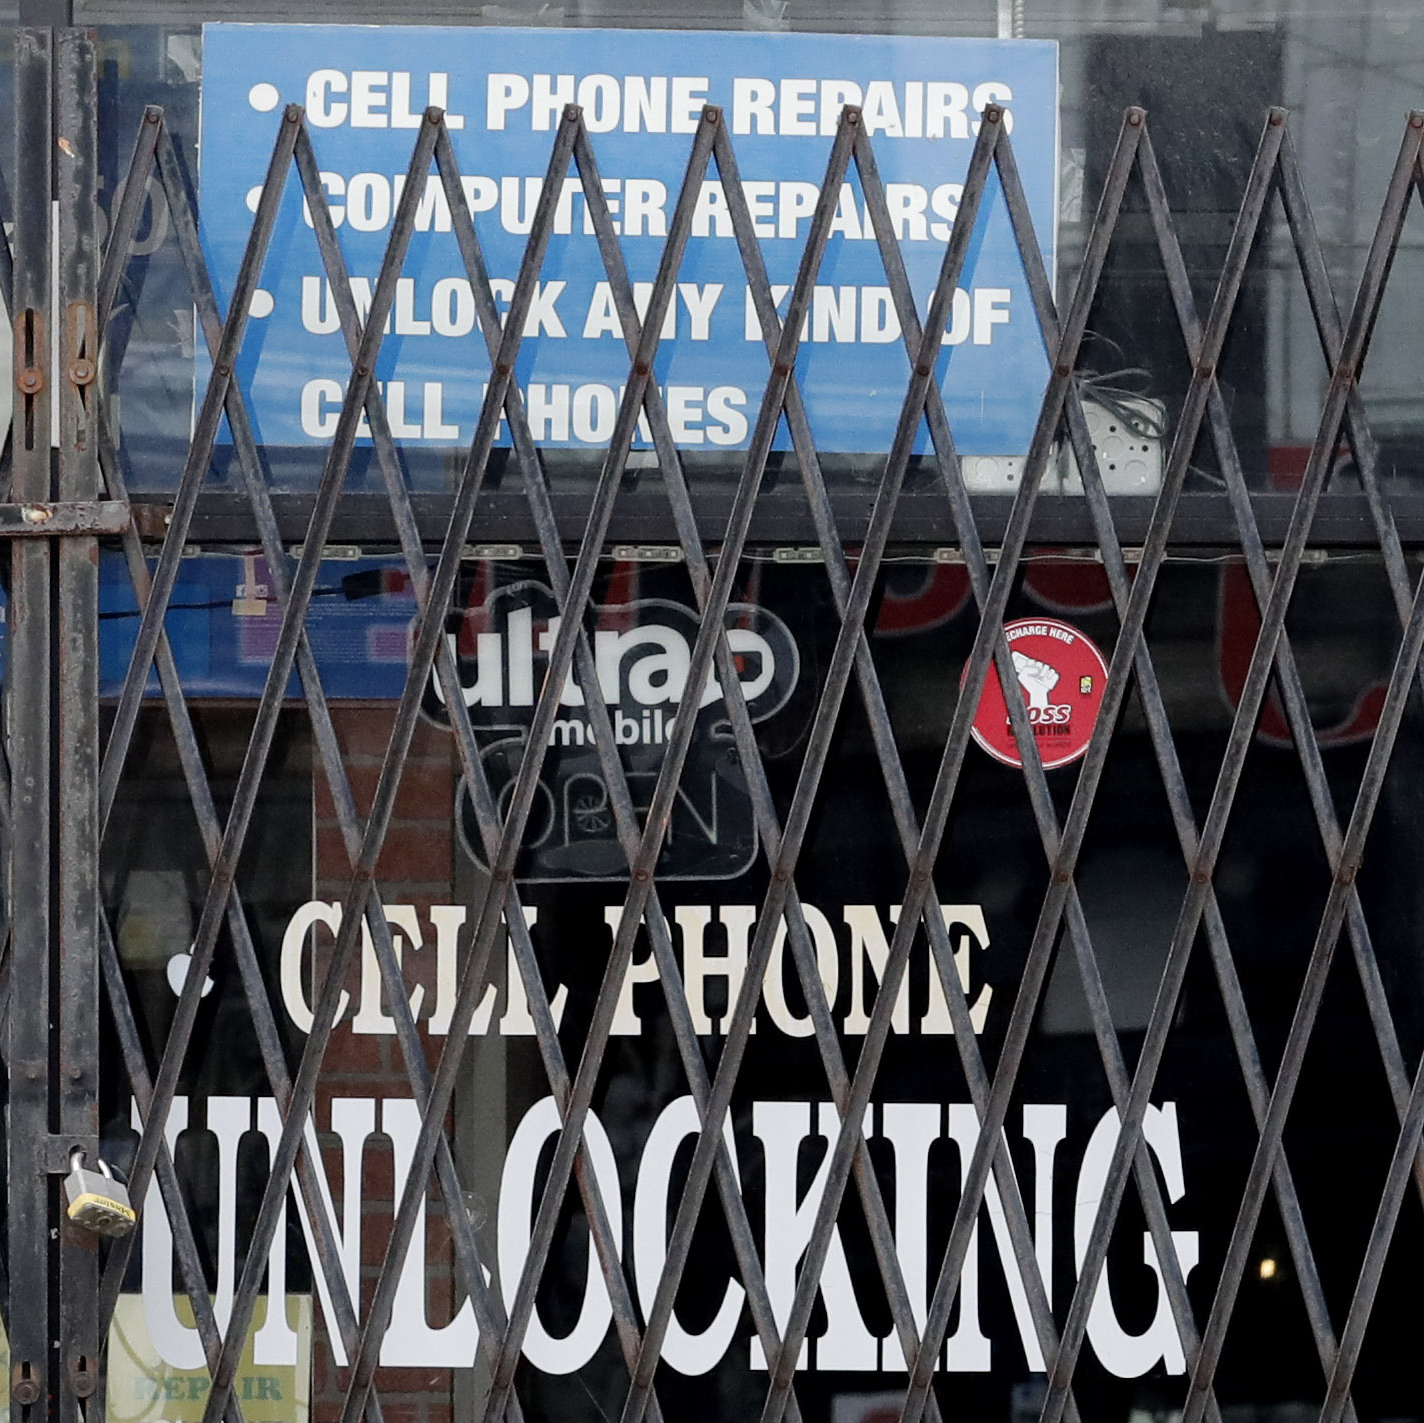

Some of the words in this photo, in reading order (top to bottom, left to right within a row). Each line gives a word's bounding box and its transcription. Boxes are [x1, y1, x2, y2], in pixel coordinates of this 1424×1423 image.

[304, 68, 464, 131] CELL
[485, 71, 719, 136] PHONE
[731, 76, 1016, 141] REPAIRS
[432, 606, 697, 708] ultra
[1048, 626, 1075, 645] HERE
[279, 899, 570, 1037] CELL
[603, 900, 995, 1039] PHONE
[131, 1094, 1201, 1380] UNLOCKING
